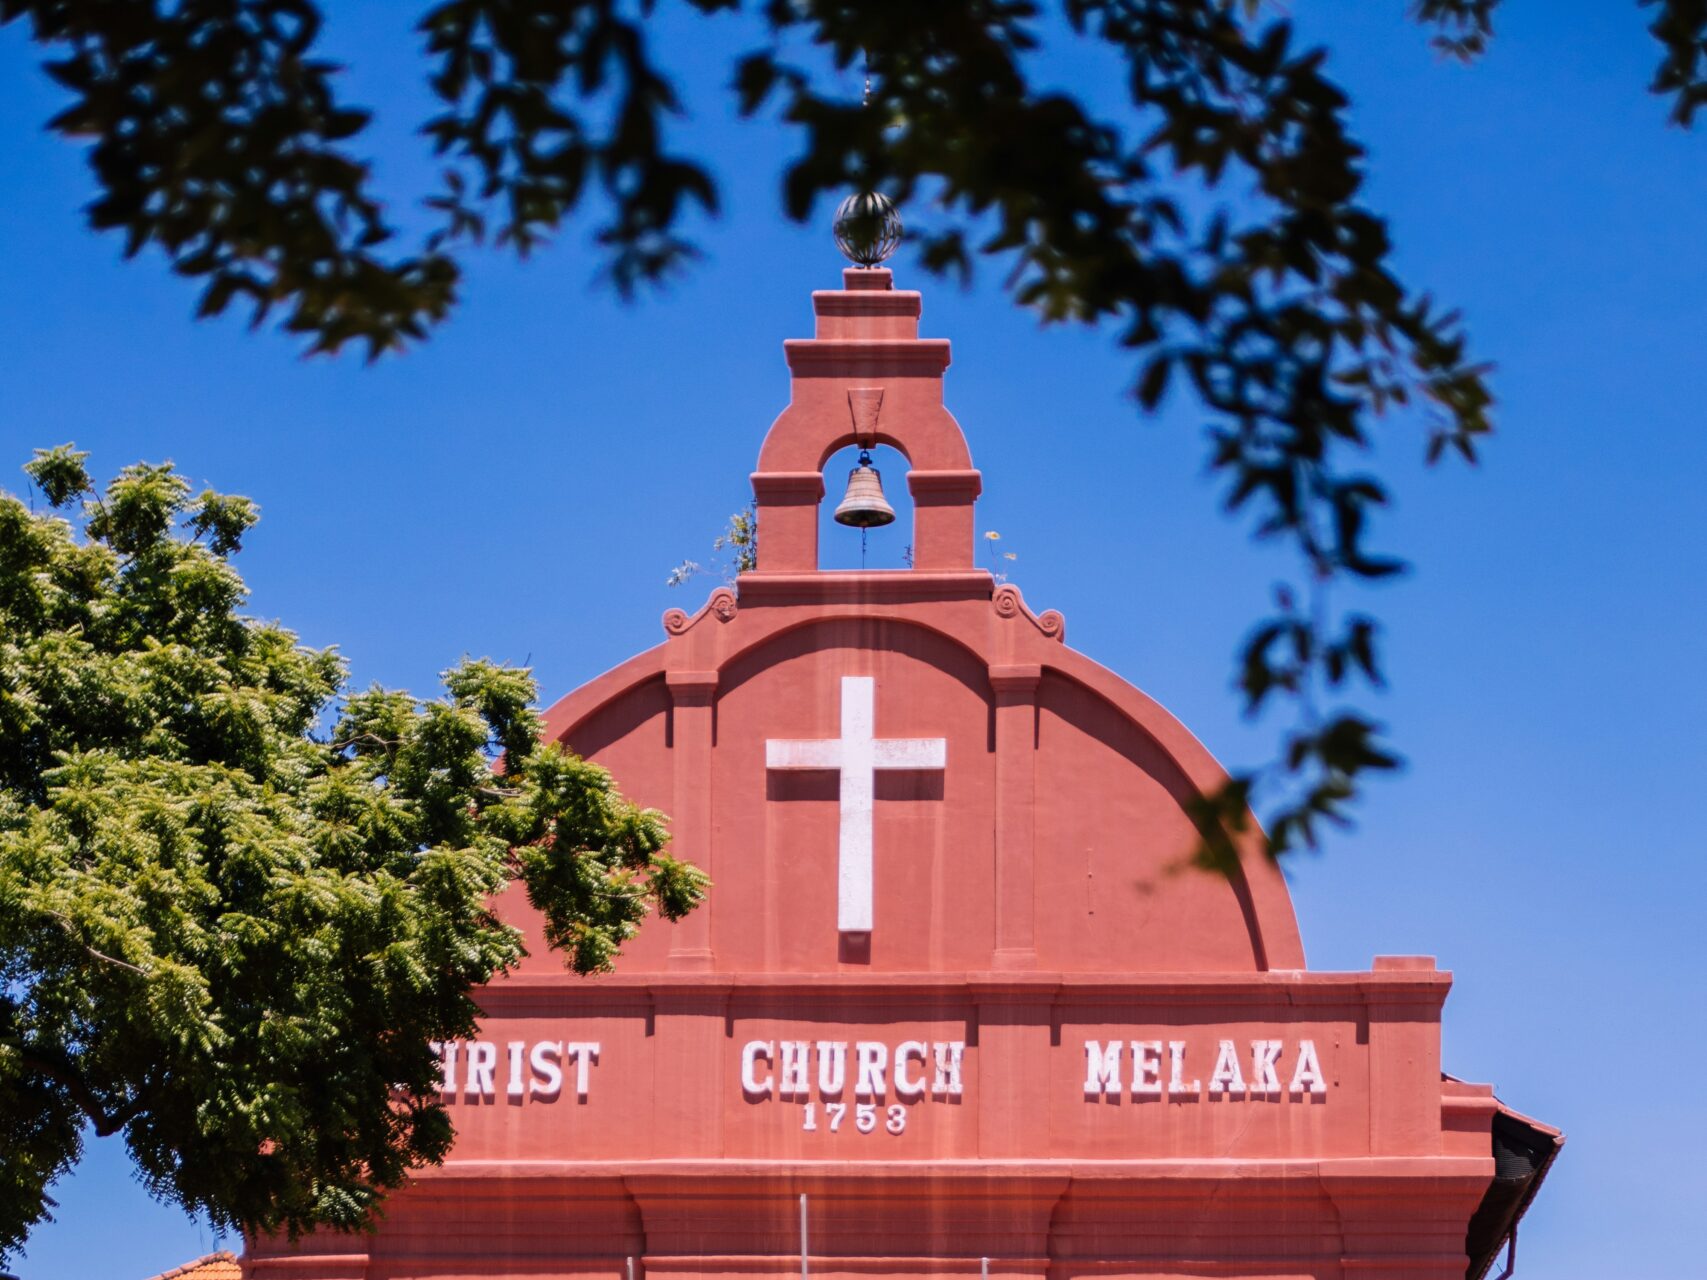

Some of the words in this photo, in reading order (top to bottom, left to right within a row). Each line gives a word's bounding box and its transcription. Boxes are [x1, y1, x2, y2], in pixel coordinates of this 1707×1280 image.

[392, 1040, 600, 1094] HRIST
[741, 1040, 964, 1094] CHURCH
[1083, 1040, 1327, 1093] MELAKA
[803, 1102, 907, 1135] 1753
